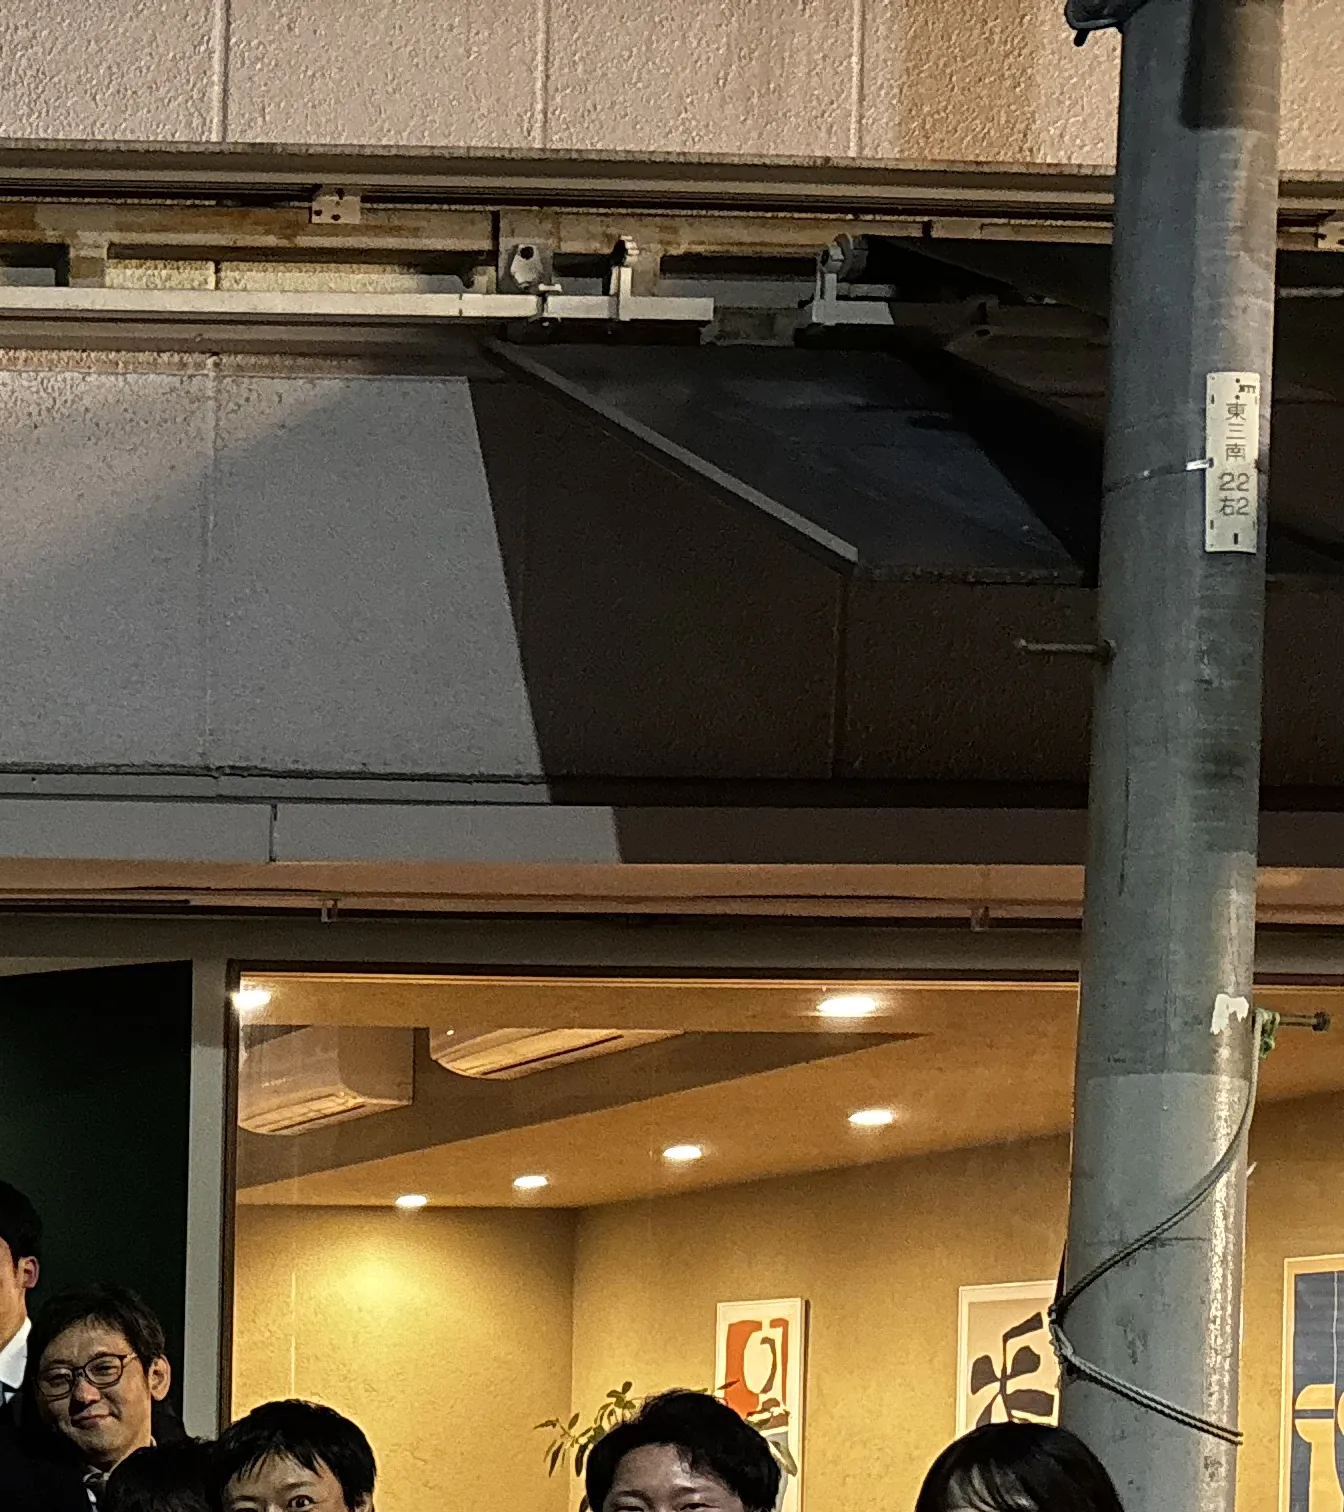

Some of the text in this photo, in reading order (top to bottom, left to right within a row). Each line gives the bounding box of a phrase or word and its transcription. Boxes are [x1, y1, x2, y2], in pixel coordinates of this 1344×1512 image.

[1225, 401, 1247, 461] 東三南
[1218, 472, 1250, 492] 22
[1217, 495, 1249, 517] 右2
